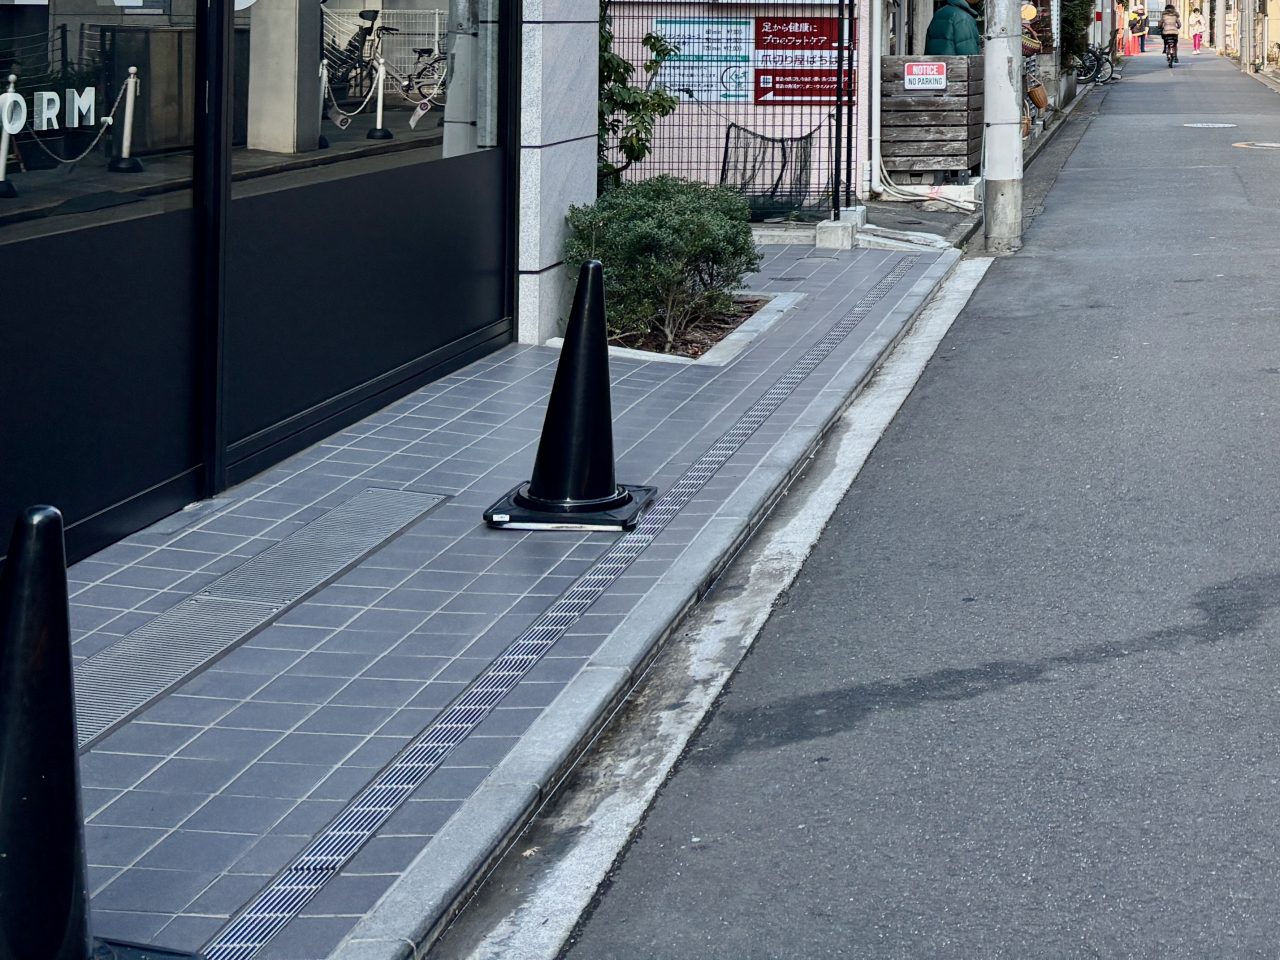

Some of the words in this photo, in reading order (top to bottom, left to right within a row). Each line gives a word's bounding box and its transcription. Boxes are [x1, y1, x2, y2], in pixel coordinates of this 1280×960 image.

[912, 65, 939, 75] NOTICE
[908, 78, 916, 86] NO
[918, 77, 942, 86] PARKING
